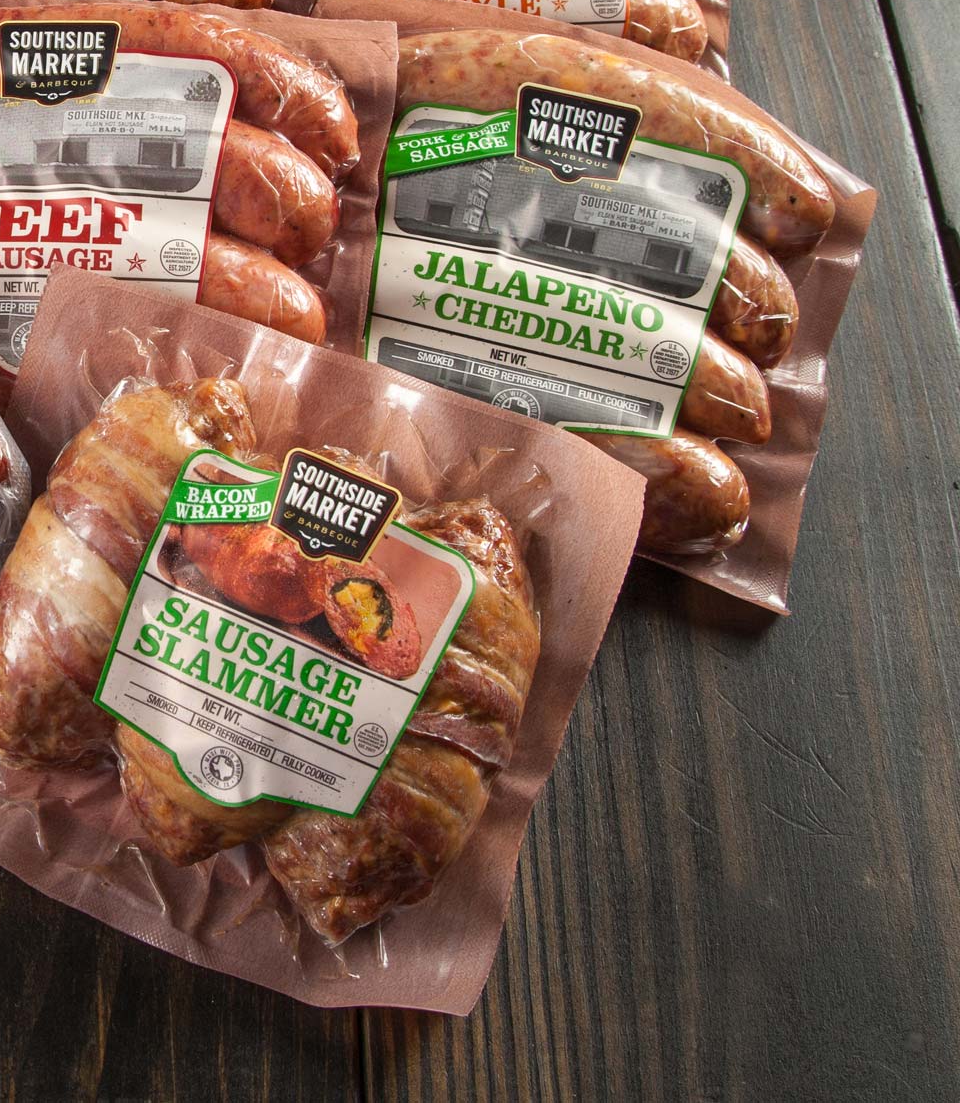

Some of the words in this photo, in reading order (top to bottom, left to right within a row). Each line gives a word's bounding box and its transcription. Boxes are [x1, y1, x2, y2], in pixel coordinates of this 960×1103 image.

[9, 31, 106, 50] SOUTHSIDE
[12, 52, 103, 76] MARKET
[31, 80, 94, 88] BARBEQUE
[67, 110, 122, 120] SOUTHSIDE
[529, 98, 626, 136] SOUTHSIDE
[399, 134, 447, 151] PORK
[452, 133, 465, 142] &
[468, 121, 511, 140] BEEF
[527, 119, 619, 159] MARKET
[410, 137, 508, 163] SAUSAGE
[544, 149, 609, 169] BARBEQUE
[581, 196, 635, 215] SOUTHSIDE
[659, 226, 690, 239] MILK
[4, 282, 21, 292] NET
[24, 282, 39, 293] WT.
[414, 251, 664, 332] JALAPEÑO
[434, 294, 625, 360] CHEDDAR
[417, 353, 454, 367] SMOKED
[490, 348, 510, 363] NET
[508, 353, 526, 367] WT.
[478, 366, 498, 378] KEEP
[501, 371, 564, 392] REFRIGERATED
[579, 389, 605, 403] FULLY
[605, 396, 640, 412] COOKED
[186, 487, 257, 503] BACON
[293, 461, 387, 514] SOUTHSIDE
[176, 501, 272, 520] WRAPPED
[285, 482, 376, 536] MARKET
[284, 510, 295, 519] &
[297, 518, 359, 548] BARBEQUE
[156, 598, 361, 707] SAUSAGE
[134, 624, 355, 745] SLAMMER
[147, 694, 178, 715] SMOKED
[202, 698, 223, 716] NET
[222, 709, 241, 726] WT.
[196, 718, 216, 733] KEEP
[216, 727, 271, 758] REFRIGERATED
[281, 756, 305, 773] FULLY
[304, 765, 337, 786] COOKED
